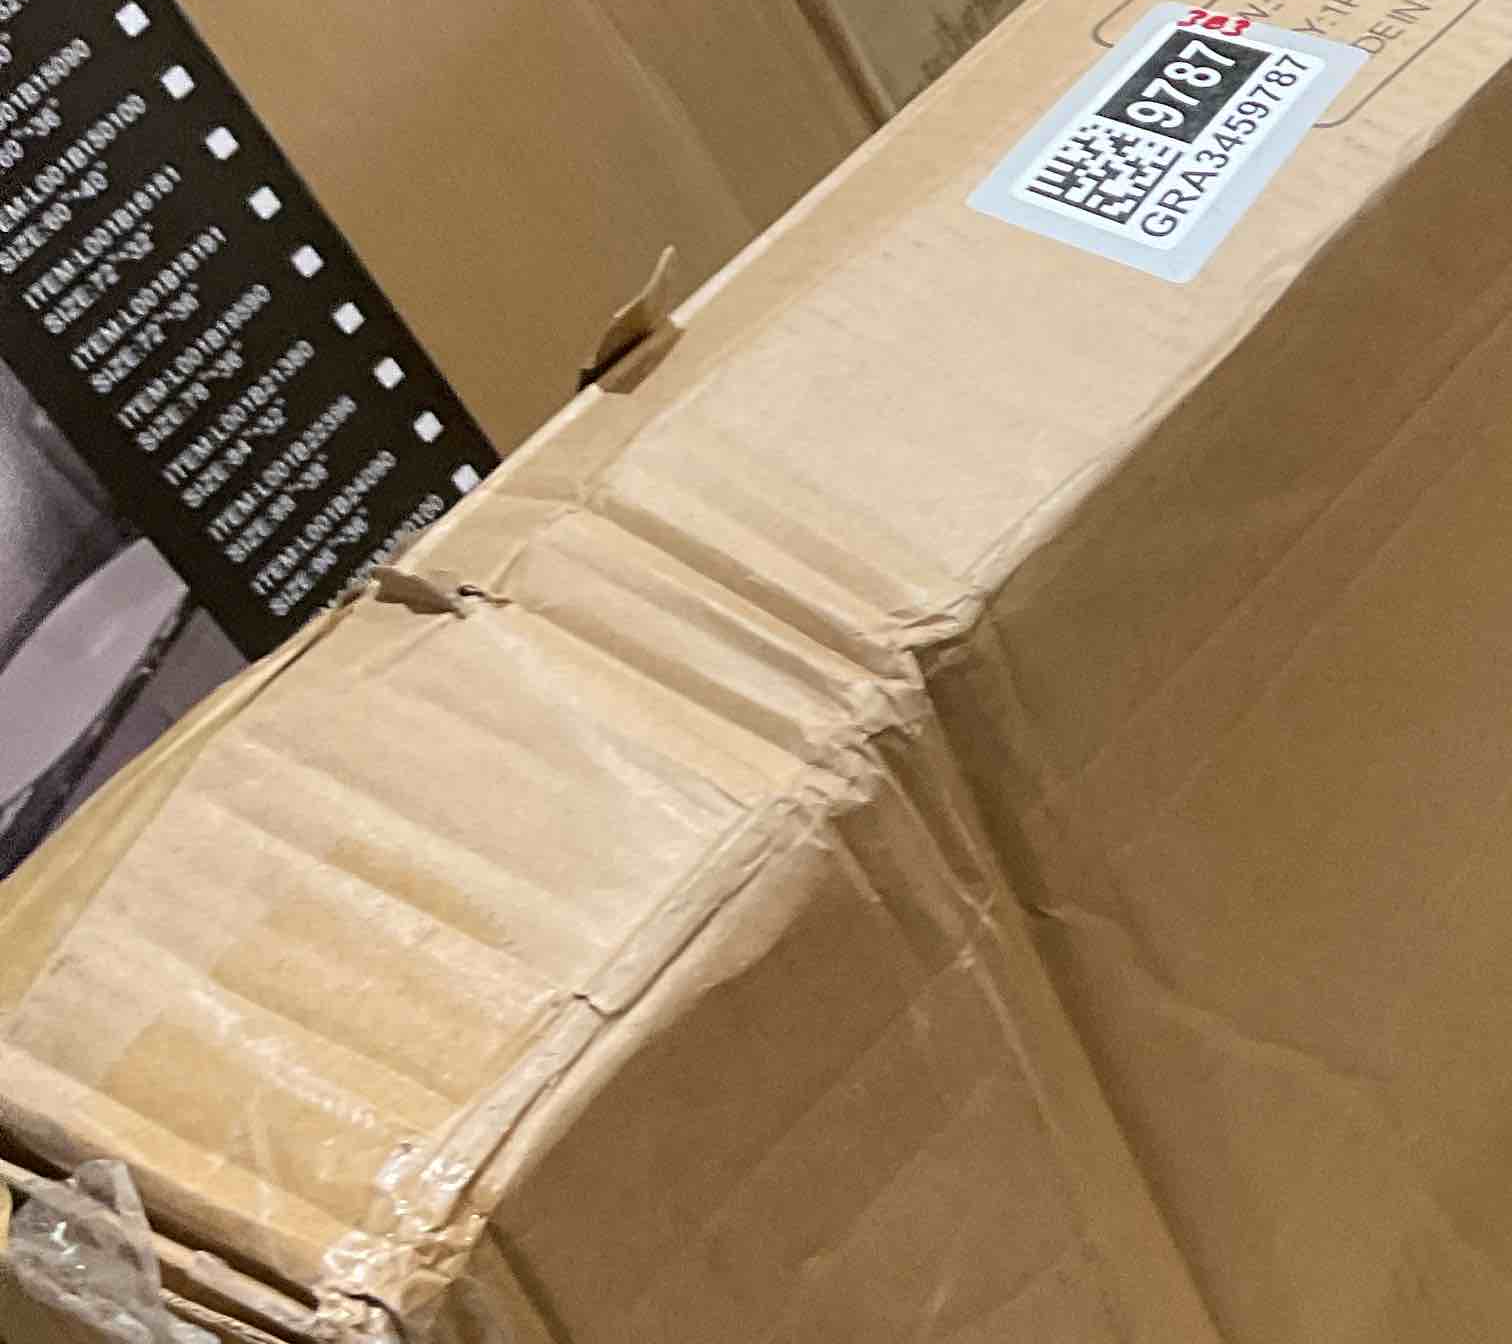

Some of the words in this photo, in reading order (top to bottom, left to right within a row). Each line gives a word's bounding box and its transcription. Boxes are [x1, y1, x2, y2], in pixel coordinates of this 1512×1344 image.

[1126, 35, 1238, 131] 9787
[1352, 21, 1404, 54] DE
[1139, 49, 1310, 242] GRA3459787
